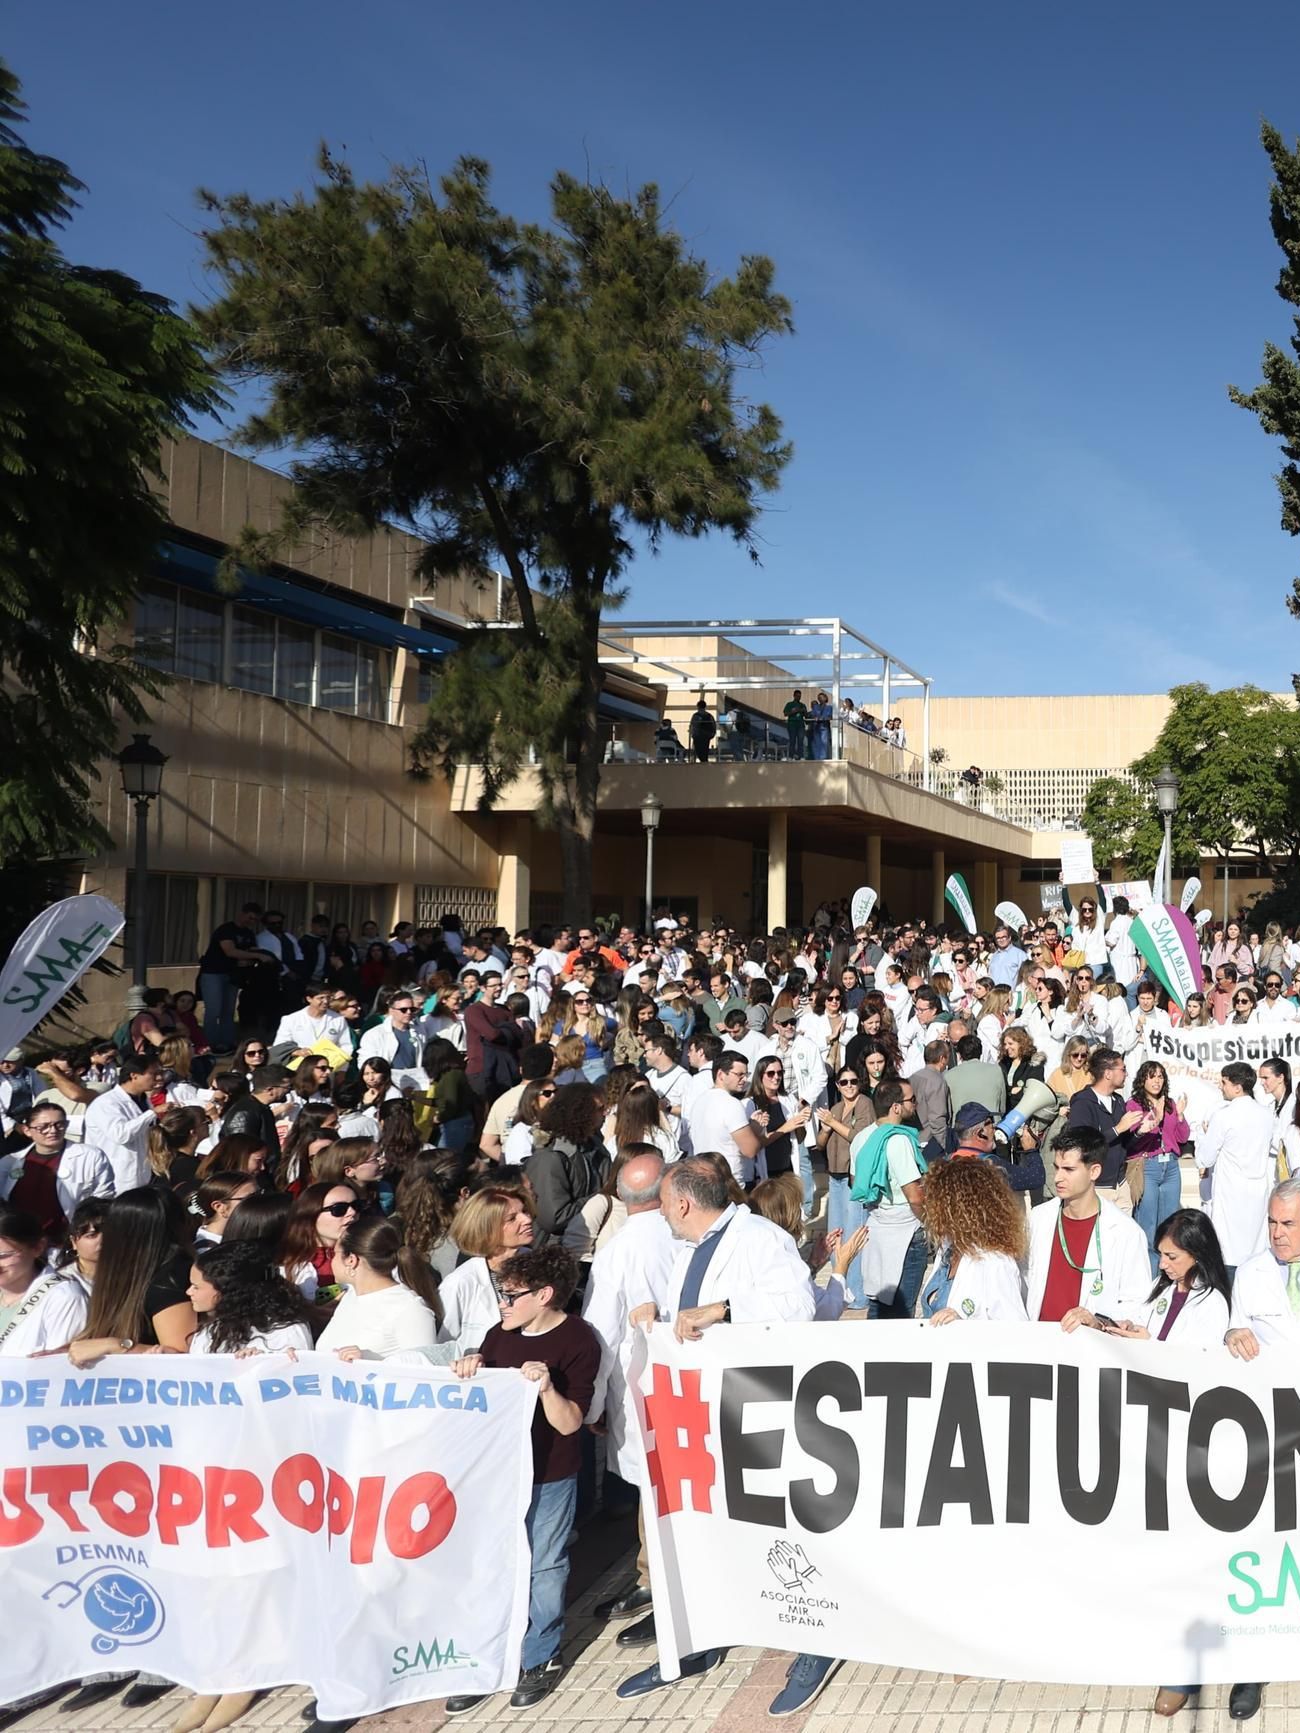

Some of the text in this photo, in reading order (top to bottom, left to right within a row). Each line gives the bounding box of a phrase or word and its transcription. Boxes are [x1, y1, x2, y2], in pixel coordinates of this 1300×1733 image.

[1152, 918, 1179, 958] SMA
[3, 937, 95, 1014] SMA
[0, 1372, 488, 1413] DE MEDICINA DE MÁLAGA
[27, 1424, 173, 1451] POR UN
[56, 1543, 150, 1569] DEMMA
[760, 1590, 839, 1611] ASOCIACIÓN
[788, 1604, 808, 1617] MIR
[778, 1613, 825, 1628] ESPAÑA
[1220, 1621, 1266, 1637] Sindicato
[392, 1636, 458, 1675] SMA
